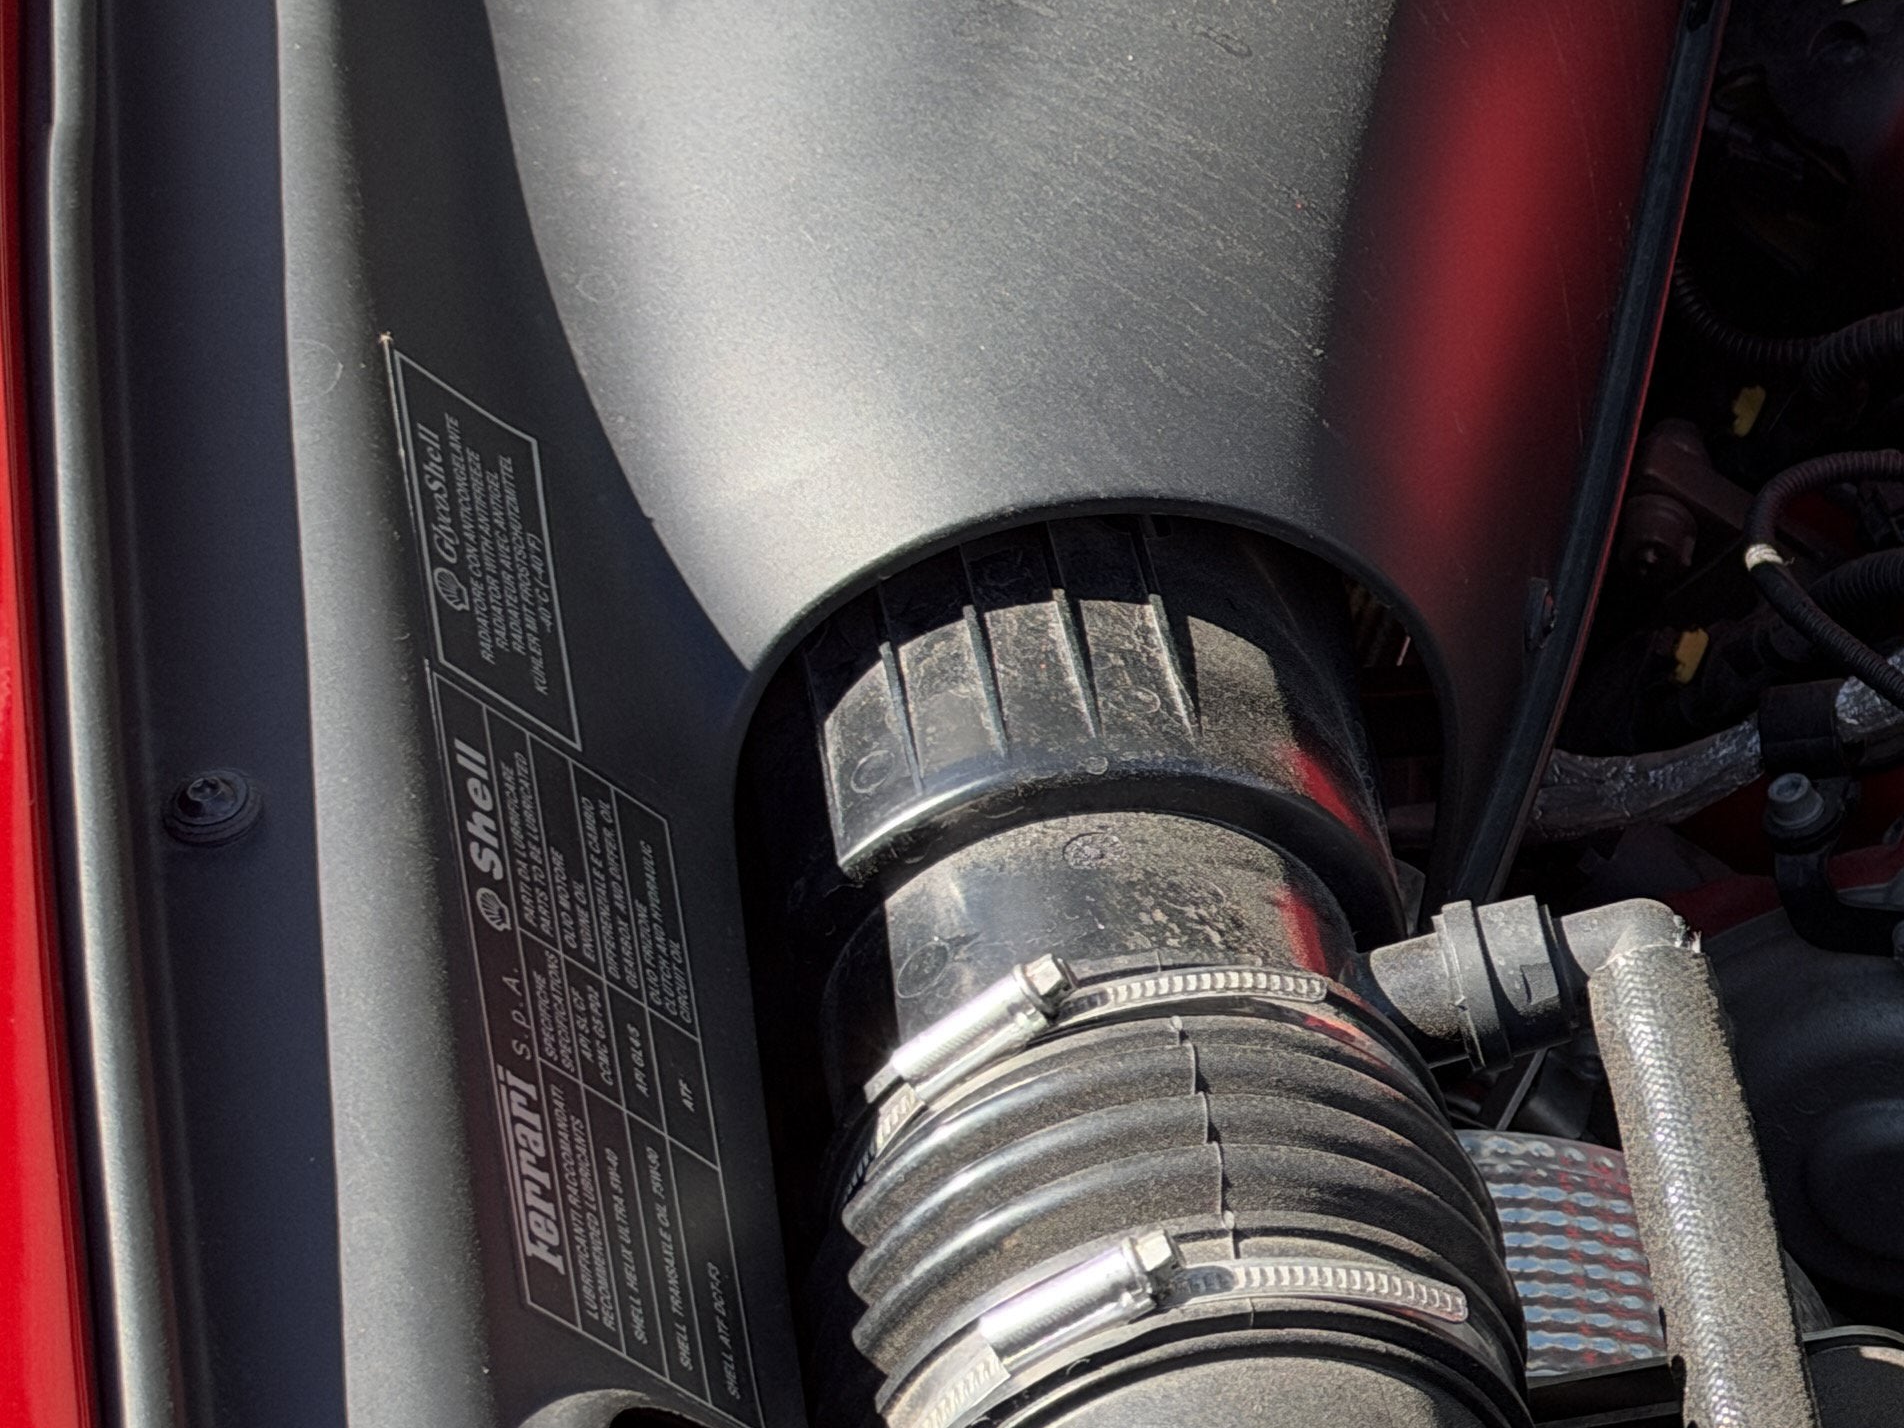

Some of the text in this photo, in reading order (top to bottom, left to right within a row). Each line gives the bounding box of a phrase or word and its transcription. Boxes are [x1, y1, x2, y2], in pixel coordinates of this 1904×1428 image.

[417, 423, 459, 564] GlycoShell
[444, 413, 495, 665] RADIATORE CON ANTICONGELANTE
[466, 447, 509, 652] RADIATOR WITH ANTIFREEZE
[485, 470, 526, 656] RADIATEUR AVEC ANTIGEL
[498, 455, 548, 696] KÜHLER MIT FROSTSCHUTZMITTEL
[454, 739, 503, 880] Shell
[500, 761, 538, 928] PARTI DA LUBRIFICARE
[514, 751, 554, 938] PARTS TO BE LUBRICATED
[550, 846, 578, 949] OLIO MOTORE
[572, 880, 596, 963] ENGINE OIL
[581, 796, 621, 980] DIFFERENZIALE E CAMBIO
[597, 799, 639, 989] GEARBOX AND DIFFER. OIL
[634, 899, 663, 1006] OLIO FRIZIONE
[639, 840, 678, 1016] CLUTCH AND HYDRAULIC
[532, 970, 558, 1061] SPECIFICHE
[544, 950, 575, 1073] SPECIFICATIONS
[578, 1033, 594, 1063] API
[668, 939, 692, 1024] CIRCUIT OIL
[595, 1039, 614, 1086] CCMC
[633, 1067, 649, 1098] API
[678, 1078, 695, 1113] ATF
[498, 1066, 565, 1274] Ferrari
[570, 1115, 616, 1331] RECOMMENDED LUBRICANTS
[570, 1208, 599, 1320] LUBRIFICANTI
[604, 1147, 648, 1345] SHELL HELIX ULTRA 5W-40
[645, 1146, 693, 1371] SHELL TRANSAXLE OIL 75W-90
[707, 1261, 741, 1400] SHELL ATF DCT-F3
